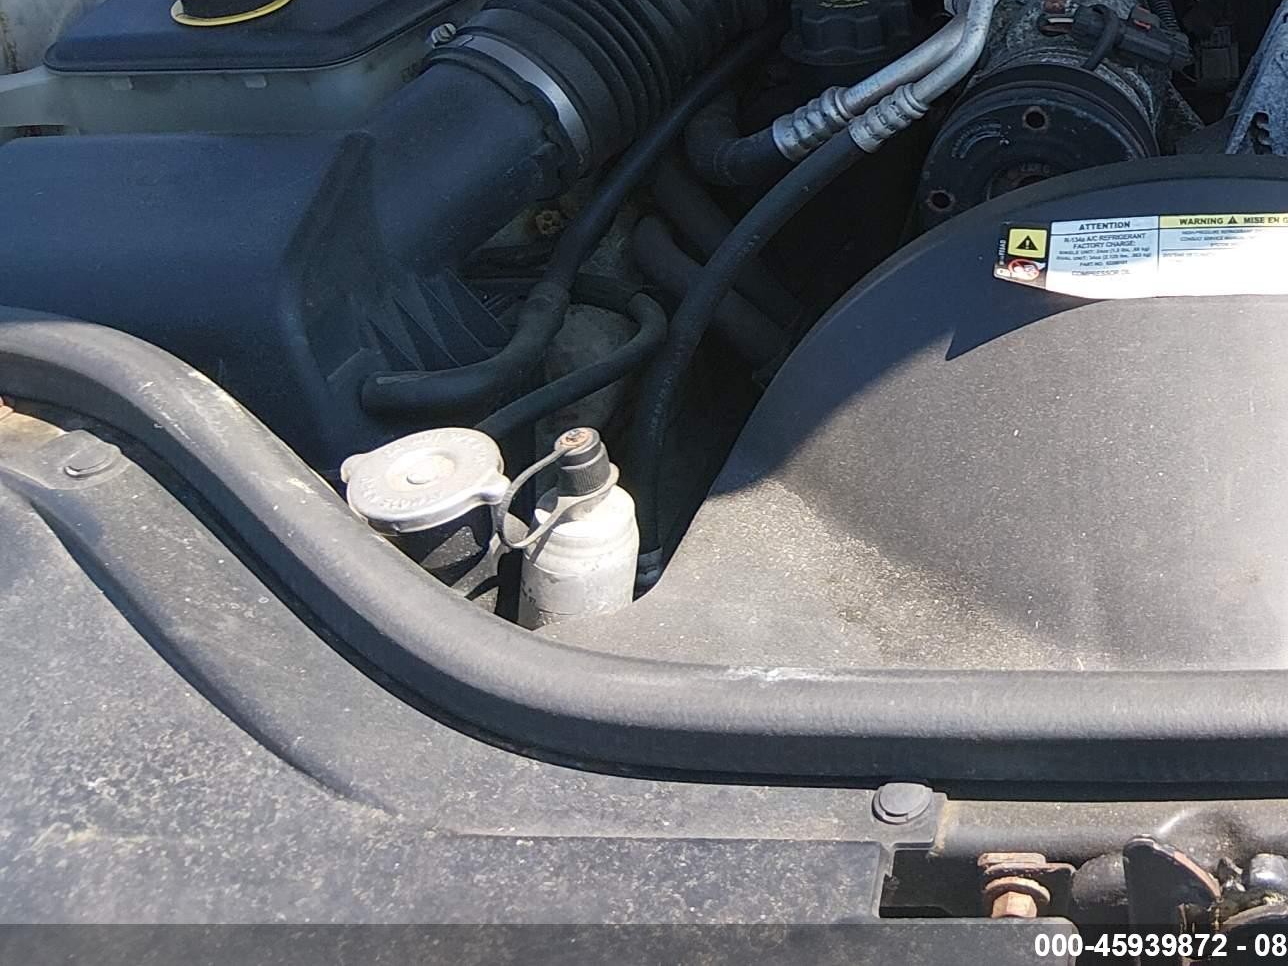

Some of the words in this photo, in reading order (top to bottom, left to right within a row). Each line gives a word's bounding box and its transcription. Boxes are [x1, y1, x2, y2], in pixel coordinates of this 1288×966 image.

[1179, 217, 1224, 225] WARNING
[1243, 216, 1265, 224] MISE
[1267, 216, 1280, 224] EN
[1078, 221, 1131, 231] ATTENTION
[1099, 232, 1147, 241] REFRIGERANT
[1073, 241, 1105, 250] FACTORY
[1105, 240, 1136, 248] CHARGE:
